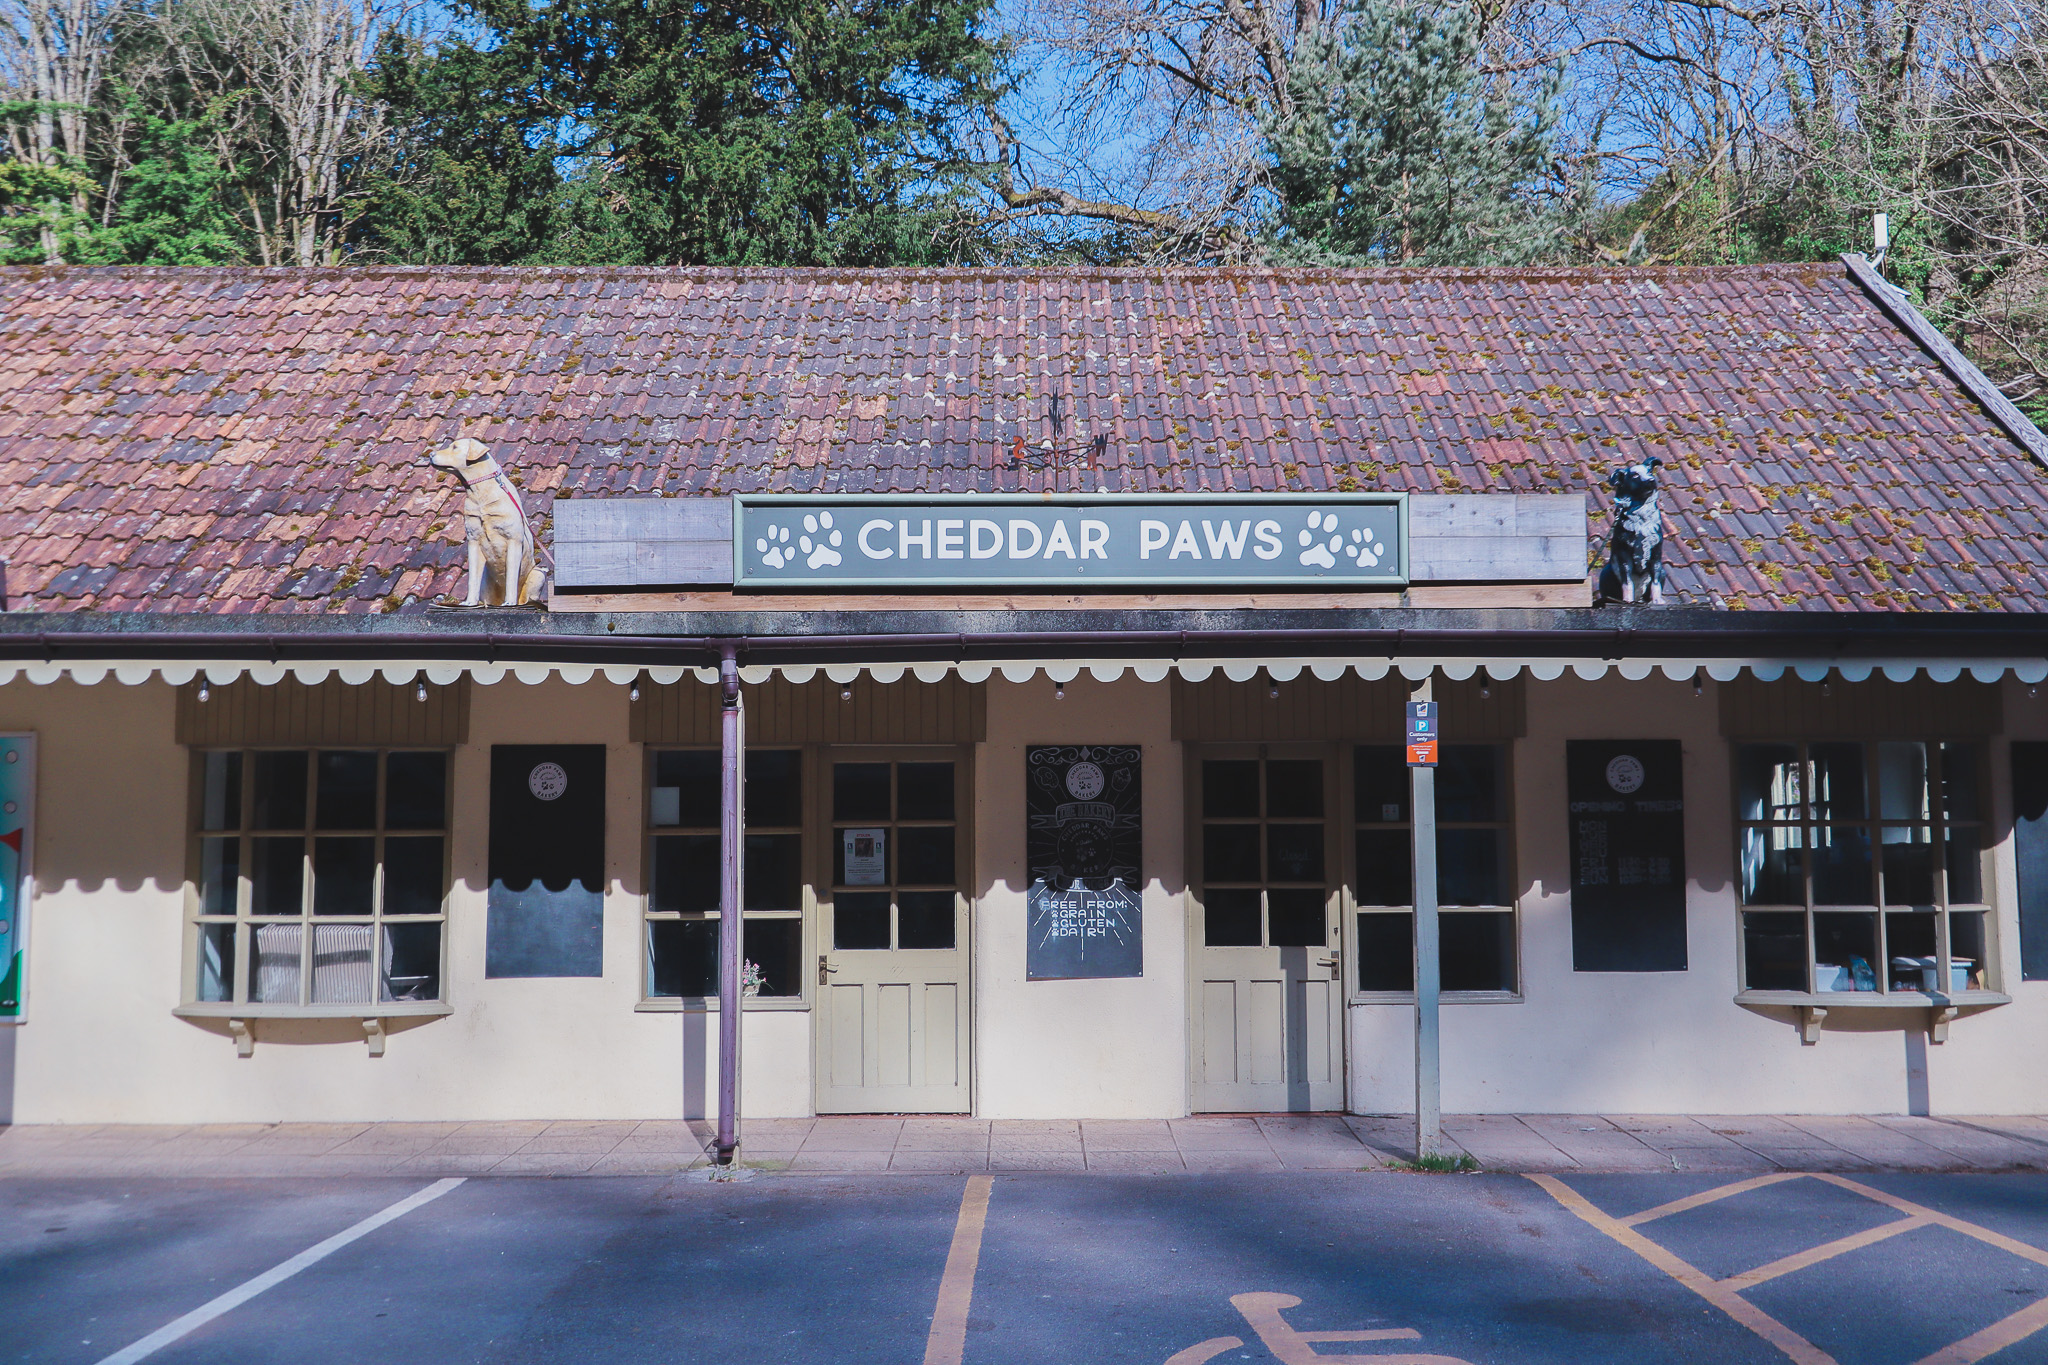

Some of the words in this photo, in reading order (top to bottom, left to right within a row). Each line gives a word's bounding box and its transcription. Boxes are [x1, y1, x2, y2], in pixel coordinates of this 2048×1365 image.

[857, 518, 1110, 560] CHEDDAR
[1140, 519, 1283, 560] PAWS
[1418, 721, 1426, 730] P
[533, 765, 552, 780] CHEDDAR
[553, 767, 563, 779] PAWS
[1070, 764, 1088, 779] CHEDDAR
[1090, 766, 1100, 779] PAWS
[537, 790, 558, 798] BAKERY
[1074, 790, 1096, 798] BAKERY
[1058, 804, 1076, 819] THE
[1077, 803, 1112, 820] BAKERY
[1062, 822, 1090, 841] CHEDDAR
[1093, 825, 1109, 841] PAWS
[1041, 900, 1077, 909] FREE
[1087, 900, 1127, 909] FROM:
[1060, 909, 1106, 919] GRAIN
[1060, 918, 1115, 927] GLUTEN
[1060, 928, 1106, 937] DAIRY
